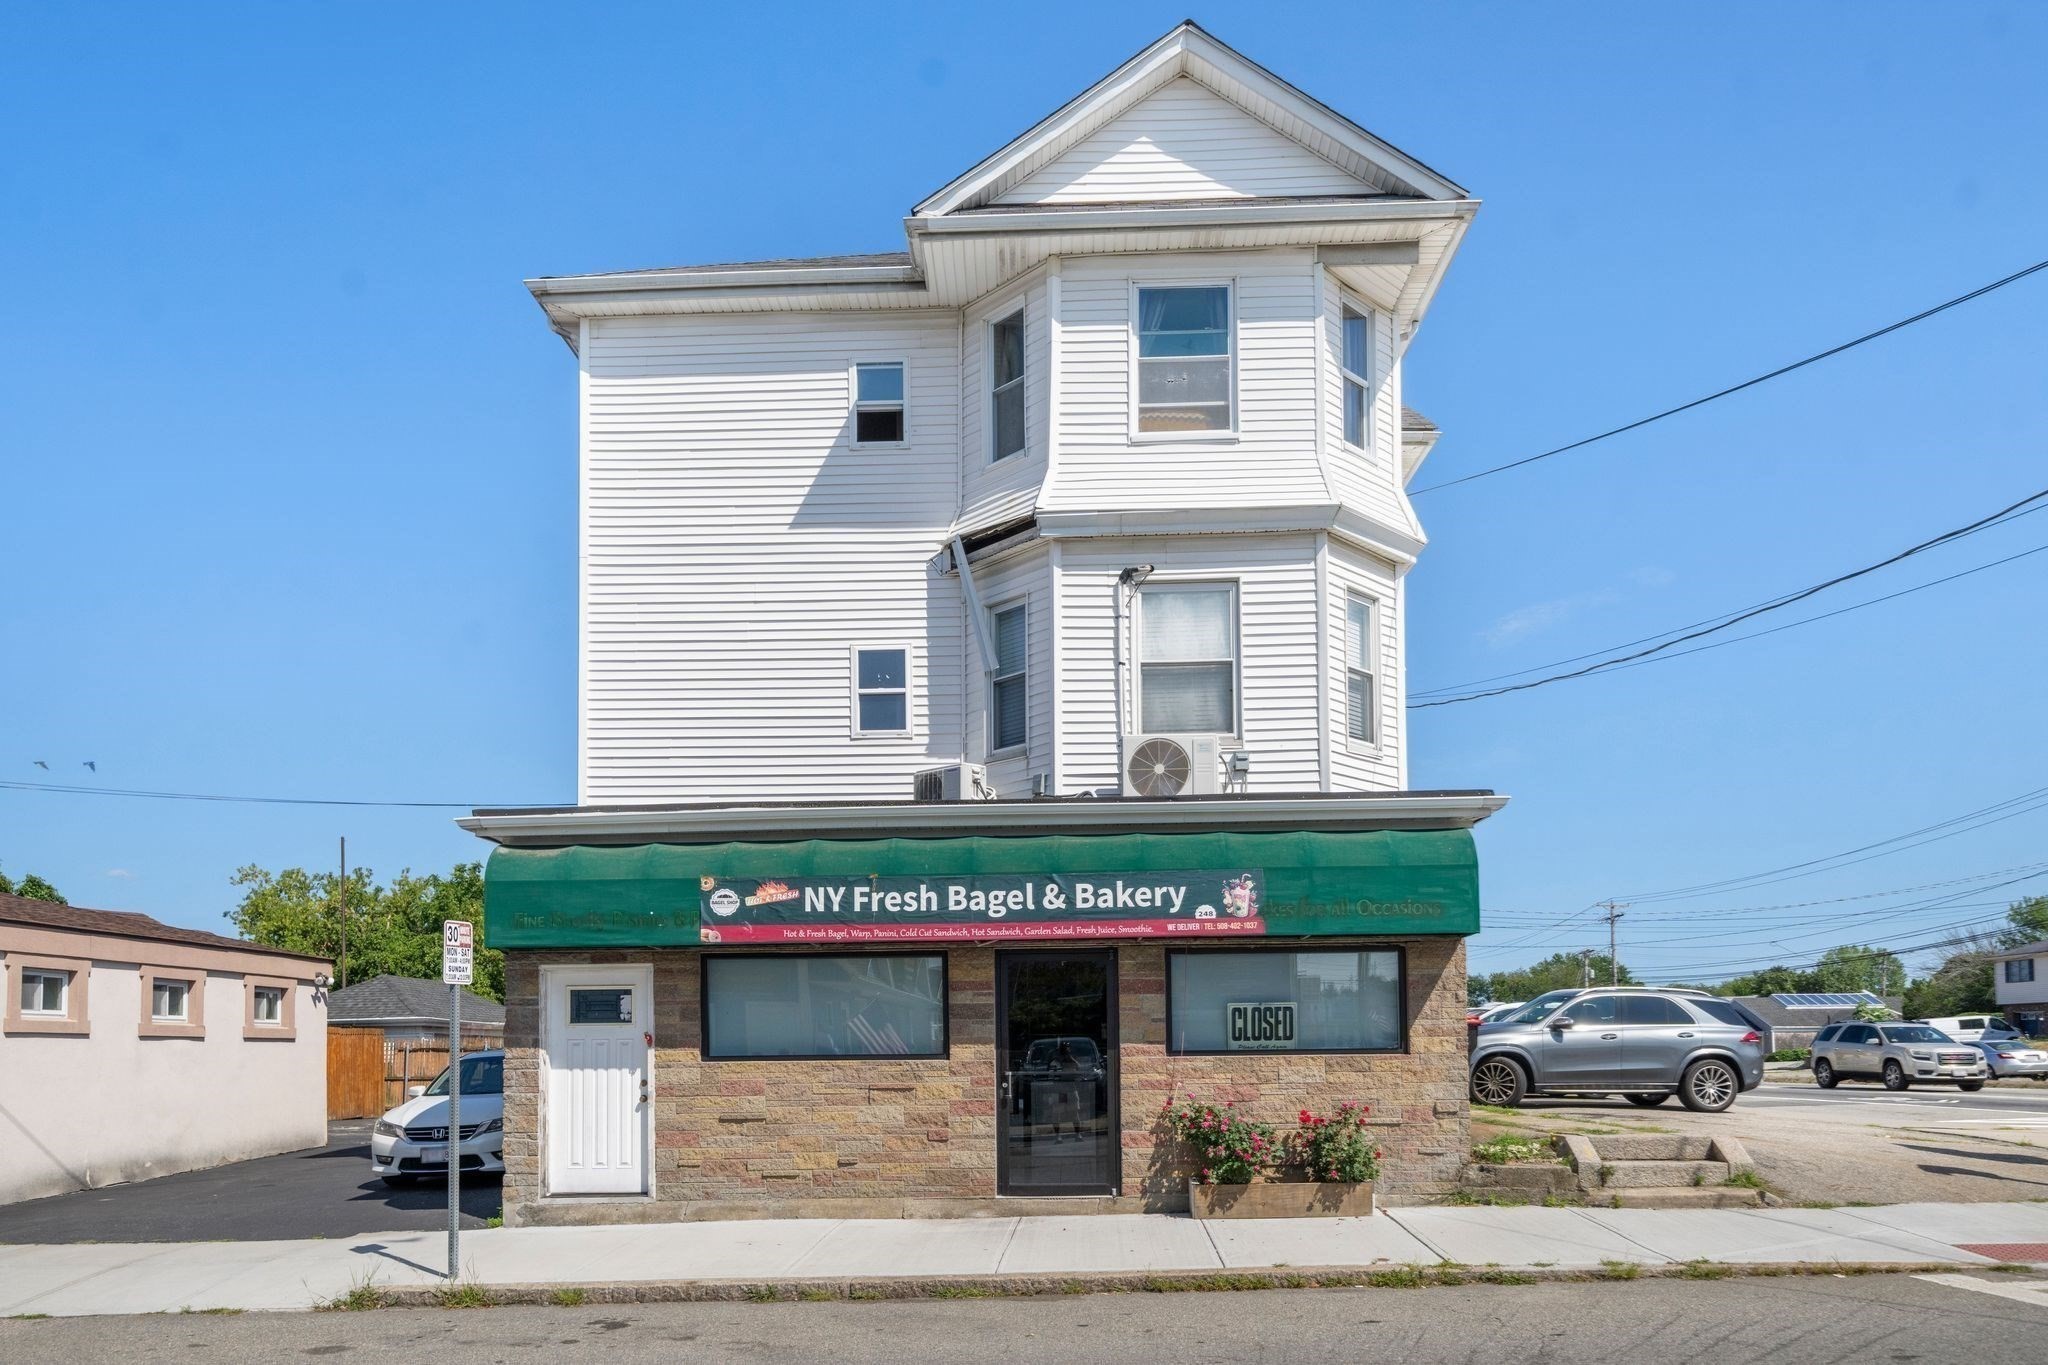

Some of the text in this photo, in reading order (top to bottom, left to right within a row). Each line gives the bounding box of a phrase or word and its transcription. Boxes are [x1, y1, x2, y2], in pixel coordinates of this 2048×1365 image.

[772, 890, 800, 901] FRESH
[804, 880, 1187, 918] NY Fresh Bagel & Bakery
[807, 930, 826, 938] Fresh
[828, 929, 849, 940] Bagel,
[850, 930, 872, 939] Warp,
[874, 929, 899, 938] Panini,
[900, 928, 917, 937] Cold
[918, 929, 932, 937] Cut
[933, 928, 970, 937] Sandwich,
[971, 928, 985, 936] Hot
[986, 927, 1023, 936] Sandwich,
[1024, 926, 1051, 935] Garden
[1052, 926, 1075, 935] Salad,
[1076, 925, 1096, 934] Fresh
[1095, 925, 1117, 935] Juice,
[1166, 923, 1177, 931] WE
[1177, 923, 1200, 931] DELIVER
[447, 926, 458, 943] 30
[446, 947, 457, 956] MON
[461, 948, 470, 957] SAT
[448, 965, 468, 973] SUNDAY
[1231, 1006, 1294, 1041] CLOSED
